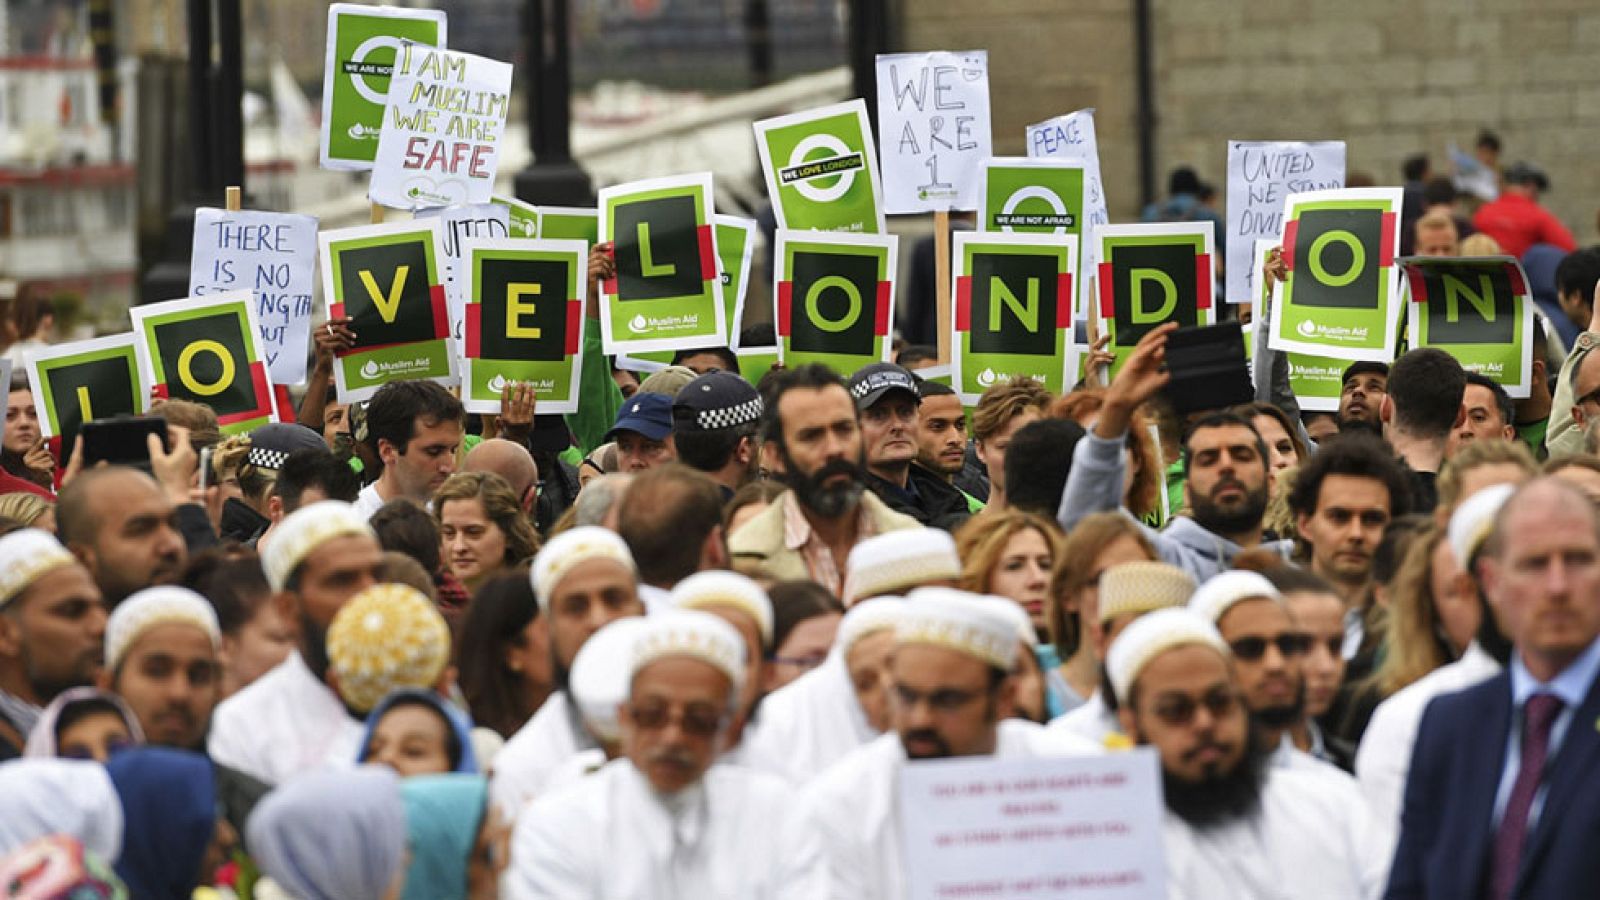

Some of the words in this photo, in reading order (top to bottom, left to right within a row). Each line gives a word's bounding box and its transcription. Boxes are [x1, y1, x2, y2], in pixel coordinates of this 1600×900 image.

[400, 40, 413, 75] I
[417, 52, 466, 82] AM
[409, 82, 507, 119] MUSLIM
[889, 64, 966, 112] WE
[393, 105, 440, 133] WE
[445, 115, 497, 142] ARE
[899, 115, 979, 155] ARE
[403, 137, 494, 179] SAFE
[783, 170, 799, 182] WE
[799, 164, 823, 179] LOVE
[823, 155, 862, 172] LONDON
[917, 154, 953, 191] 1
[1243, 149, 1315, 183] UNITED
[210, 219, 296, 254] THERE
[996, 216, 1008, 225] WE
[1010, 216, 1025, 225] ARE
[1026, 216, 1042, 225] NOT
[1044, 216, 1073, 225] AFRAID
[637, 222, 676, 277] L
[1308, 229, 1366, 287] O
[213, 259, 236, 284] IS
[255, 263, 291, 290] NO
[359, 265, 409, 324] V
[505, 282, 542, 339] E
[805, 275, 862, 332] O
[989, 275, 1039, 333] N
[1130, 268, 1178, 324] D
[1442, 274, 1496, 324] N
[648, 316, 682, 327] Muslim
[682, 314, 698, 325] Aid
[177, 339, 236, 396] O
